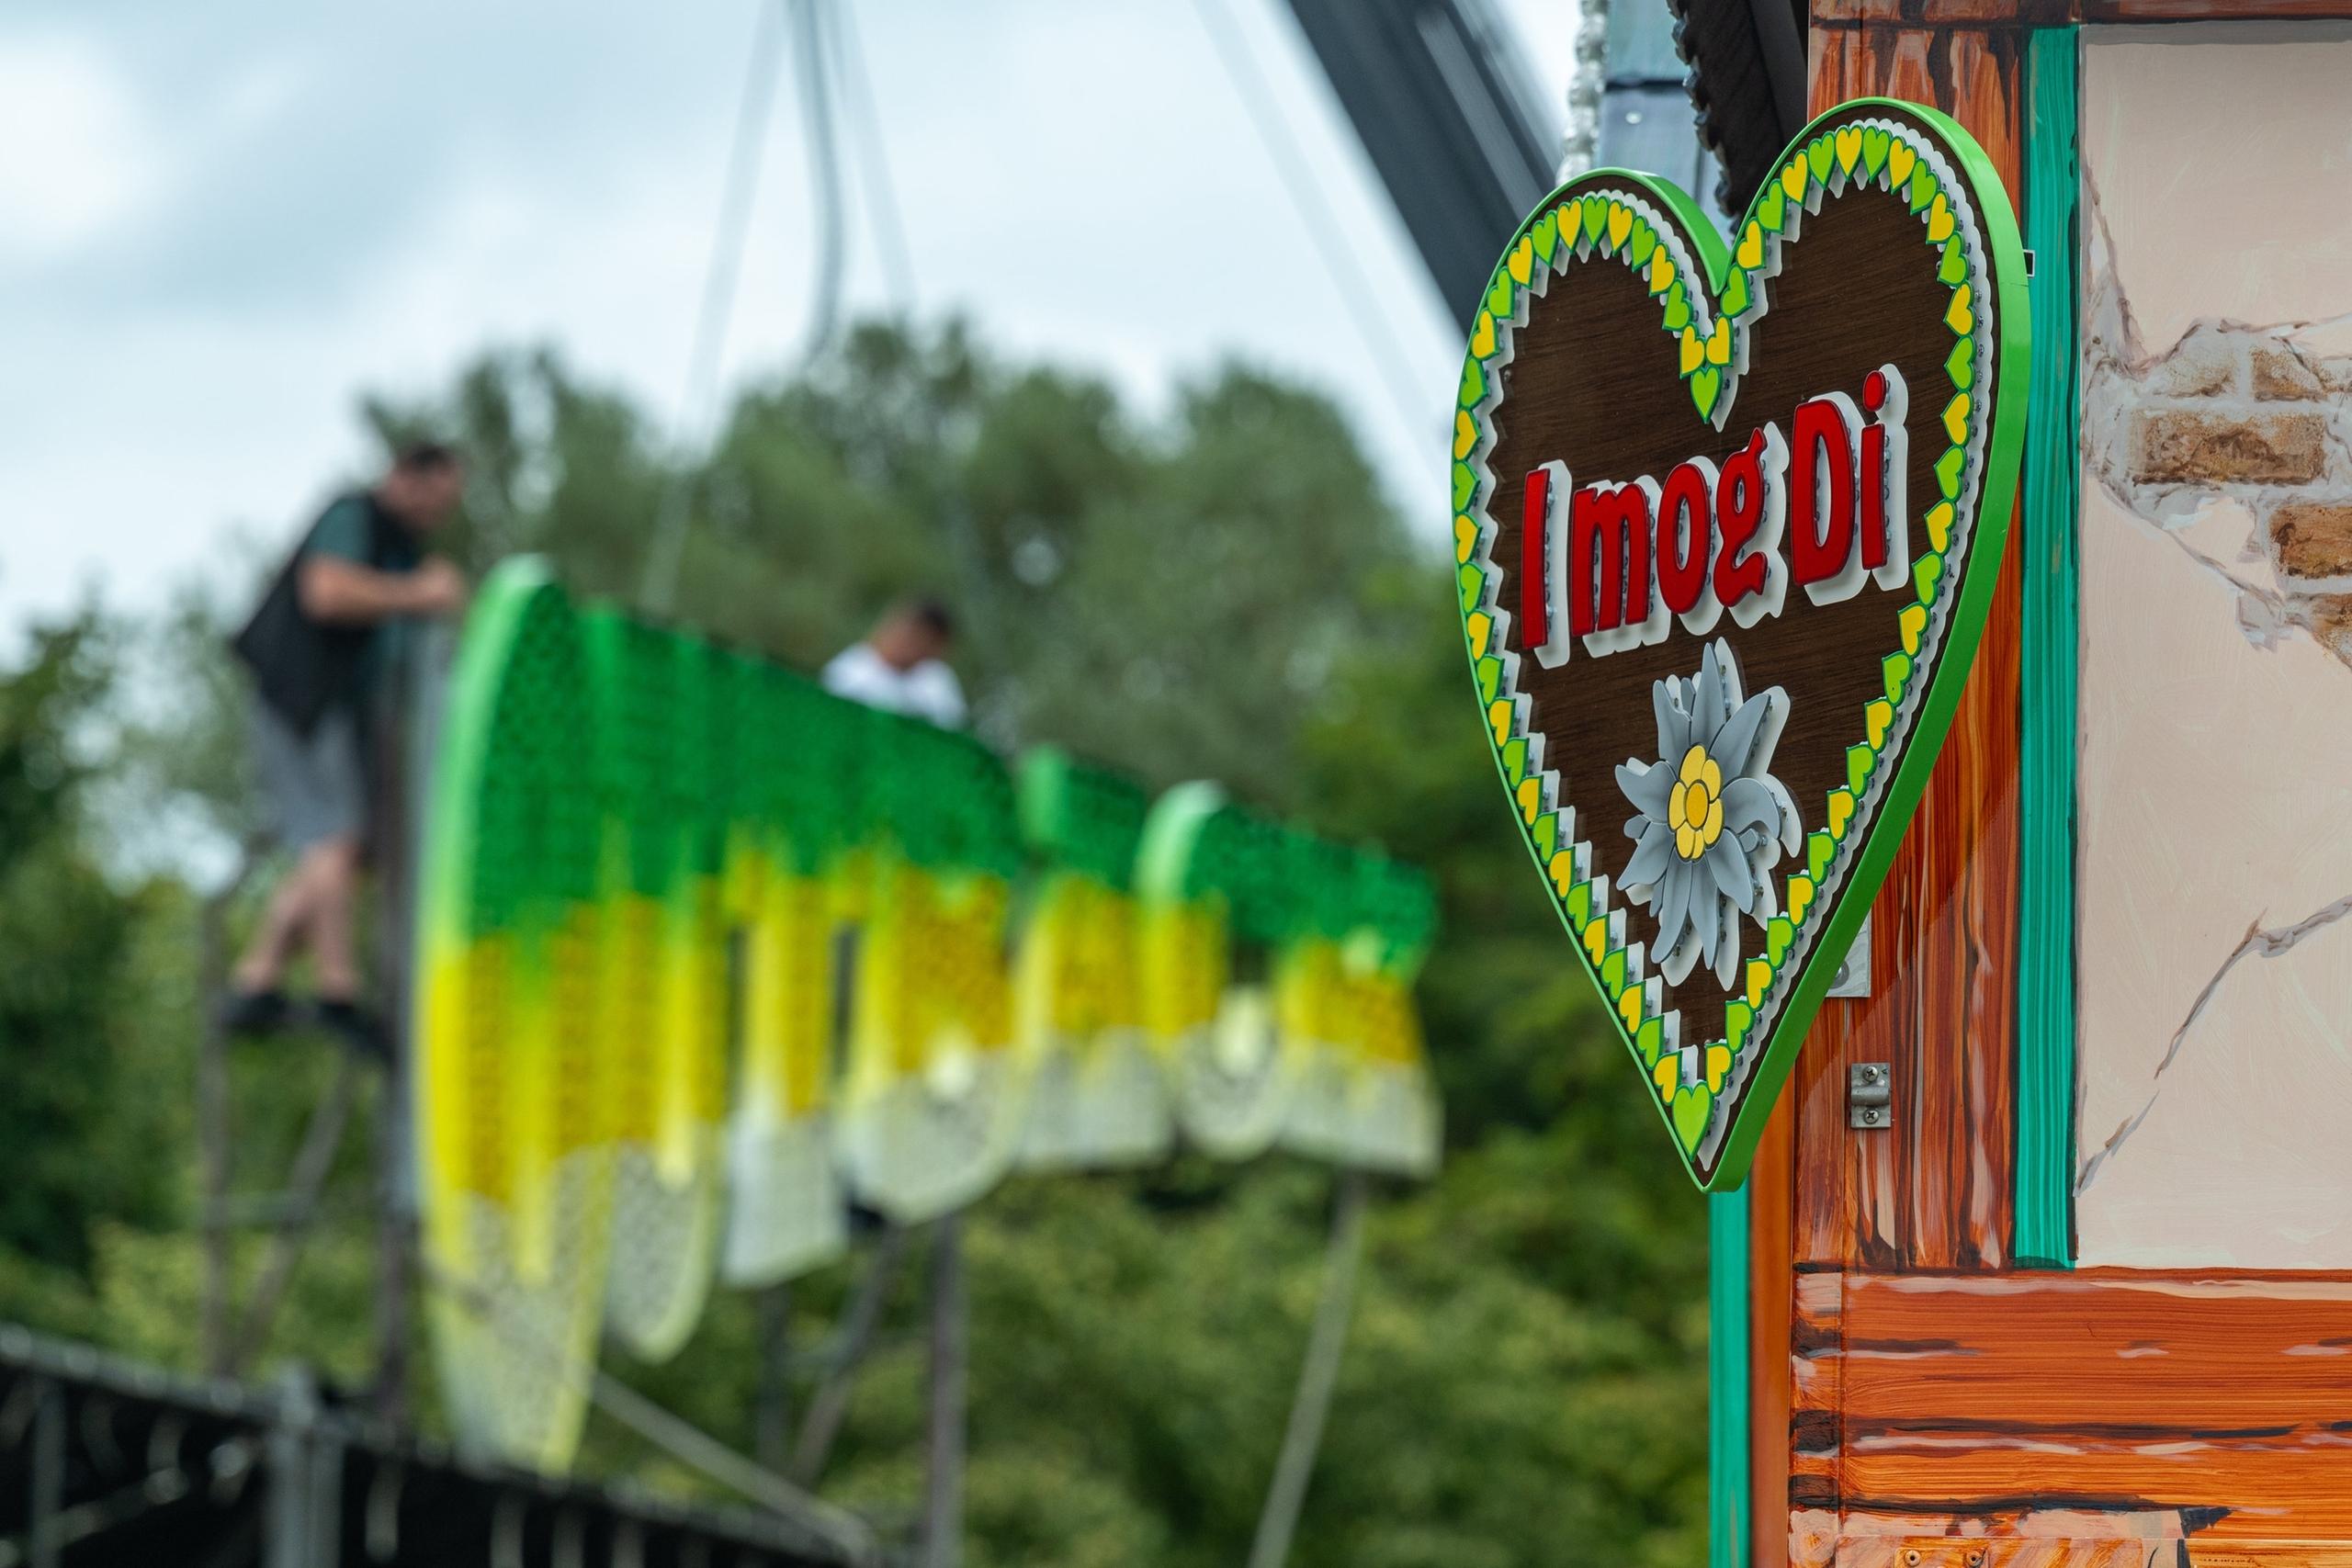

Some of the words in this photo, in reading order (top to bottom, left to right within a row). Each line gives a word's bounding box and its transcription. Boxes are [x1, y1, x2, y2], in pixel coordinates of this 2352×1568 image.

[1521, 467, 1554, 651] I
[1570, 425, 1770, 639] mog
[1791, 369, 1890, 587] Di
